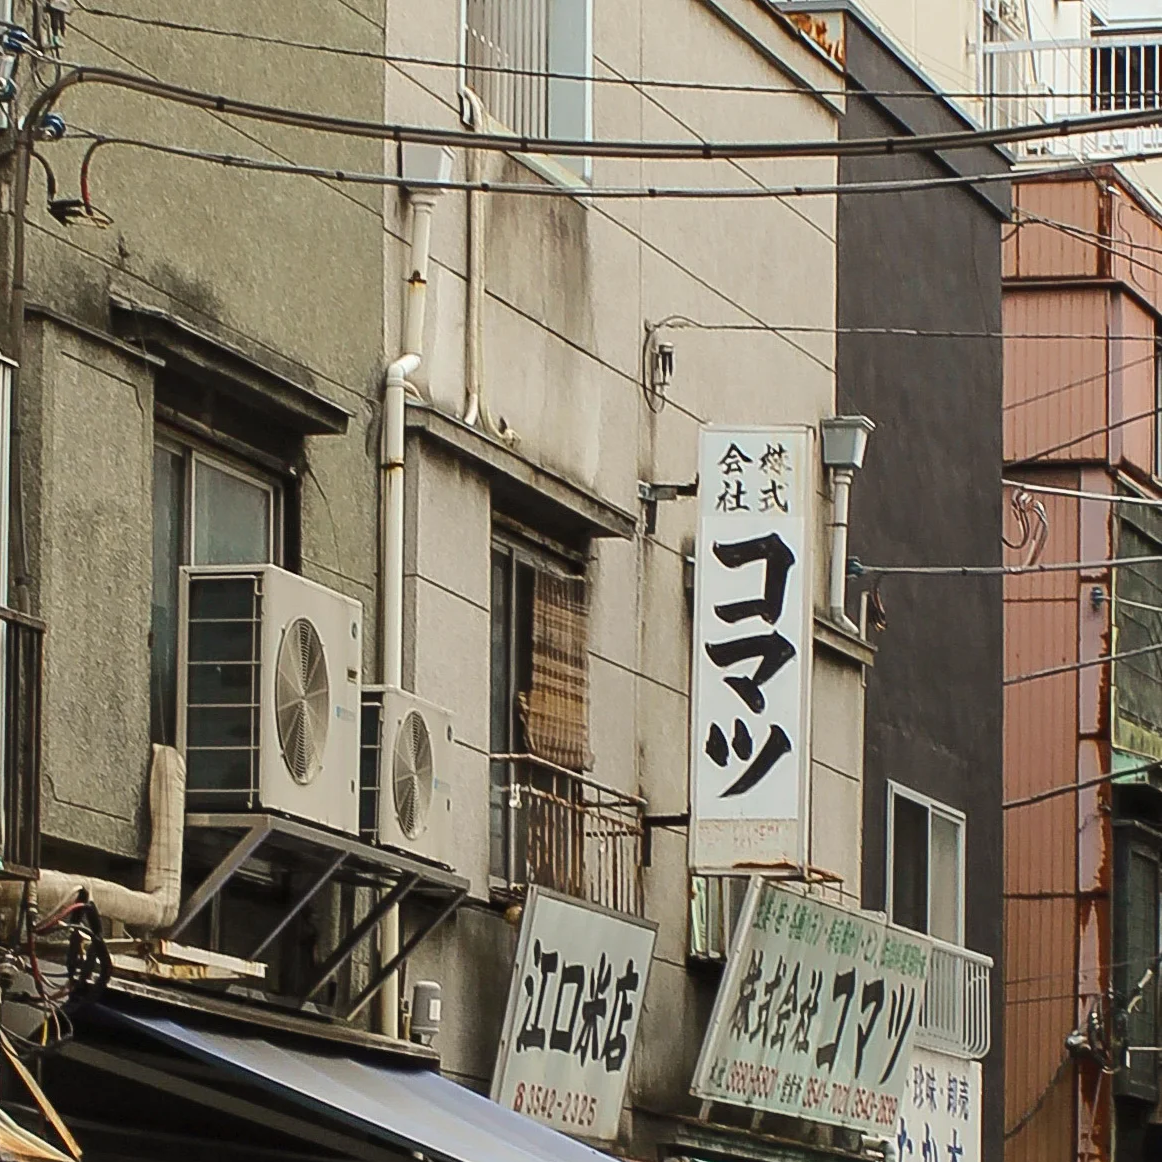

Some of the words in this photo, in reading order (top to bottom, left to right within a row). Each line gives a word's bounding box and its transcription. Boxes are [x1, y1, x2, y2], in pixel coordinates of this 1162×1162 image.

[705, 532, 797, 798] コマツ
[516, 938, 639, 1073] 江口米店
